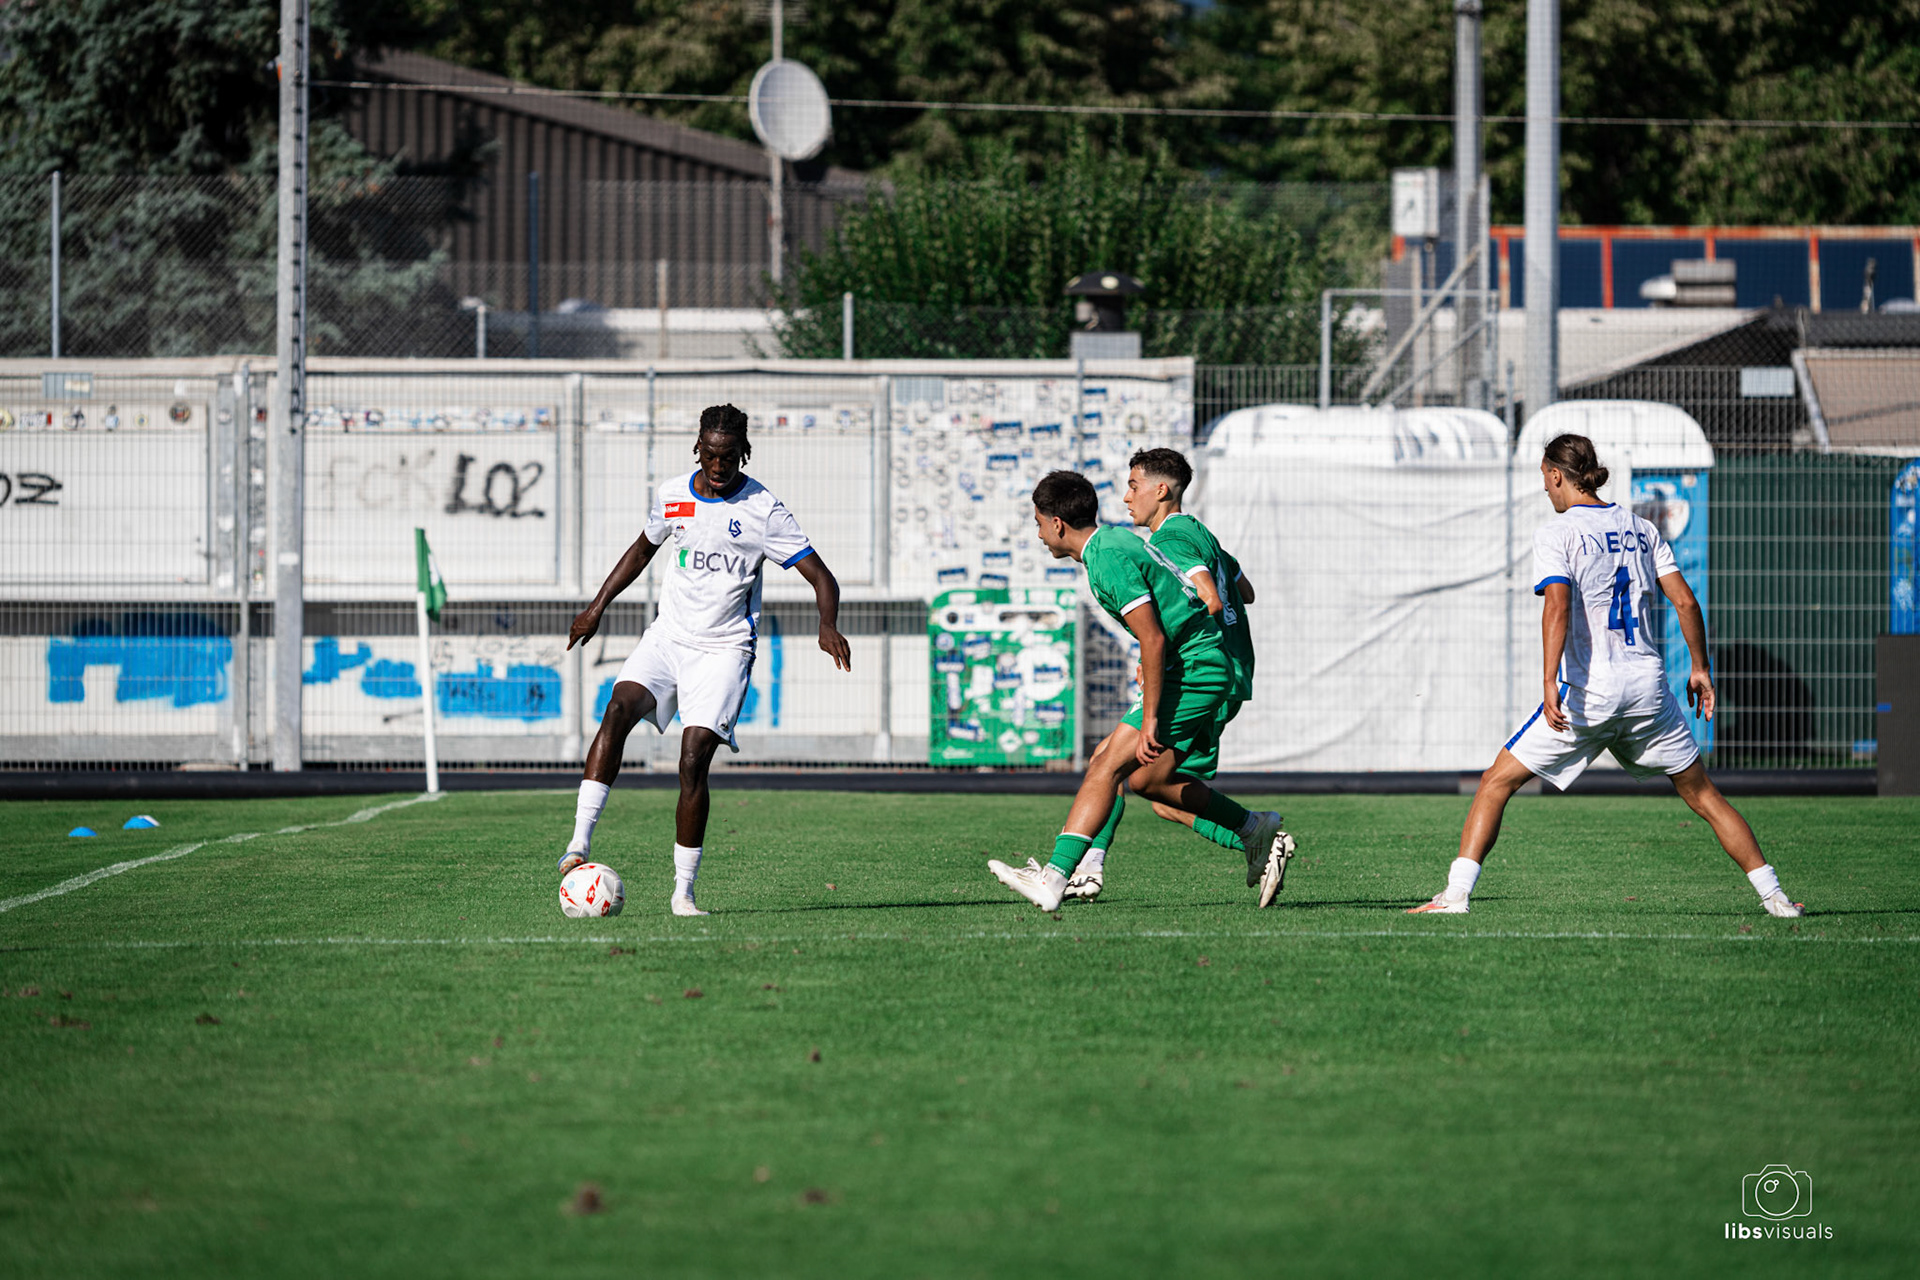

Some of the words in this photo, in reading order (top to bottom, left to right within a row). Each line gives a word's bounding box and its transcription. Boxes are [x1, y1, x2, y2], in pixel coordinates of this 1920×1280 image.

[1580, 530, 1648, 555] INEOS
[692, 551, 740, 574] BCV
[1608, 566, 1639, 646] 4
